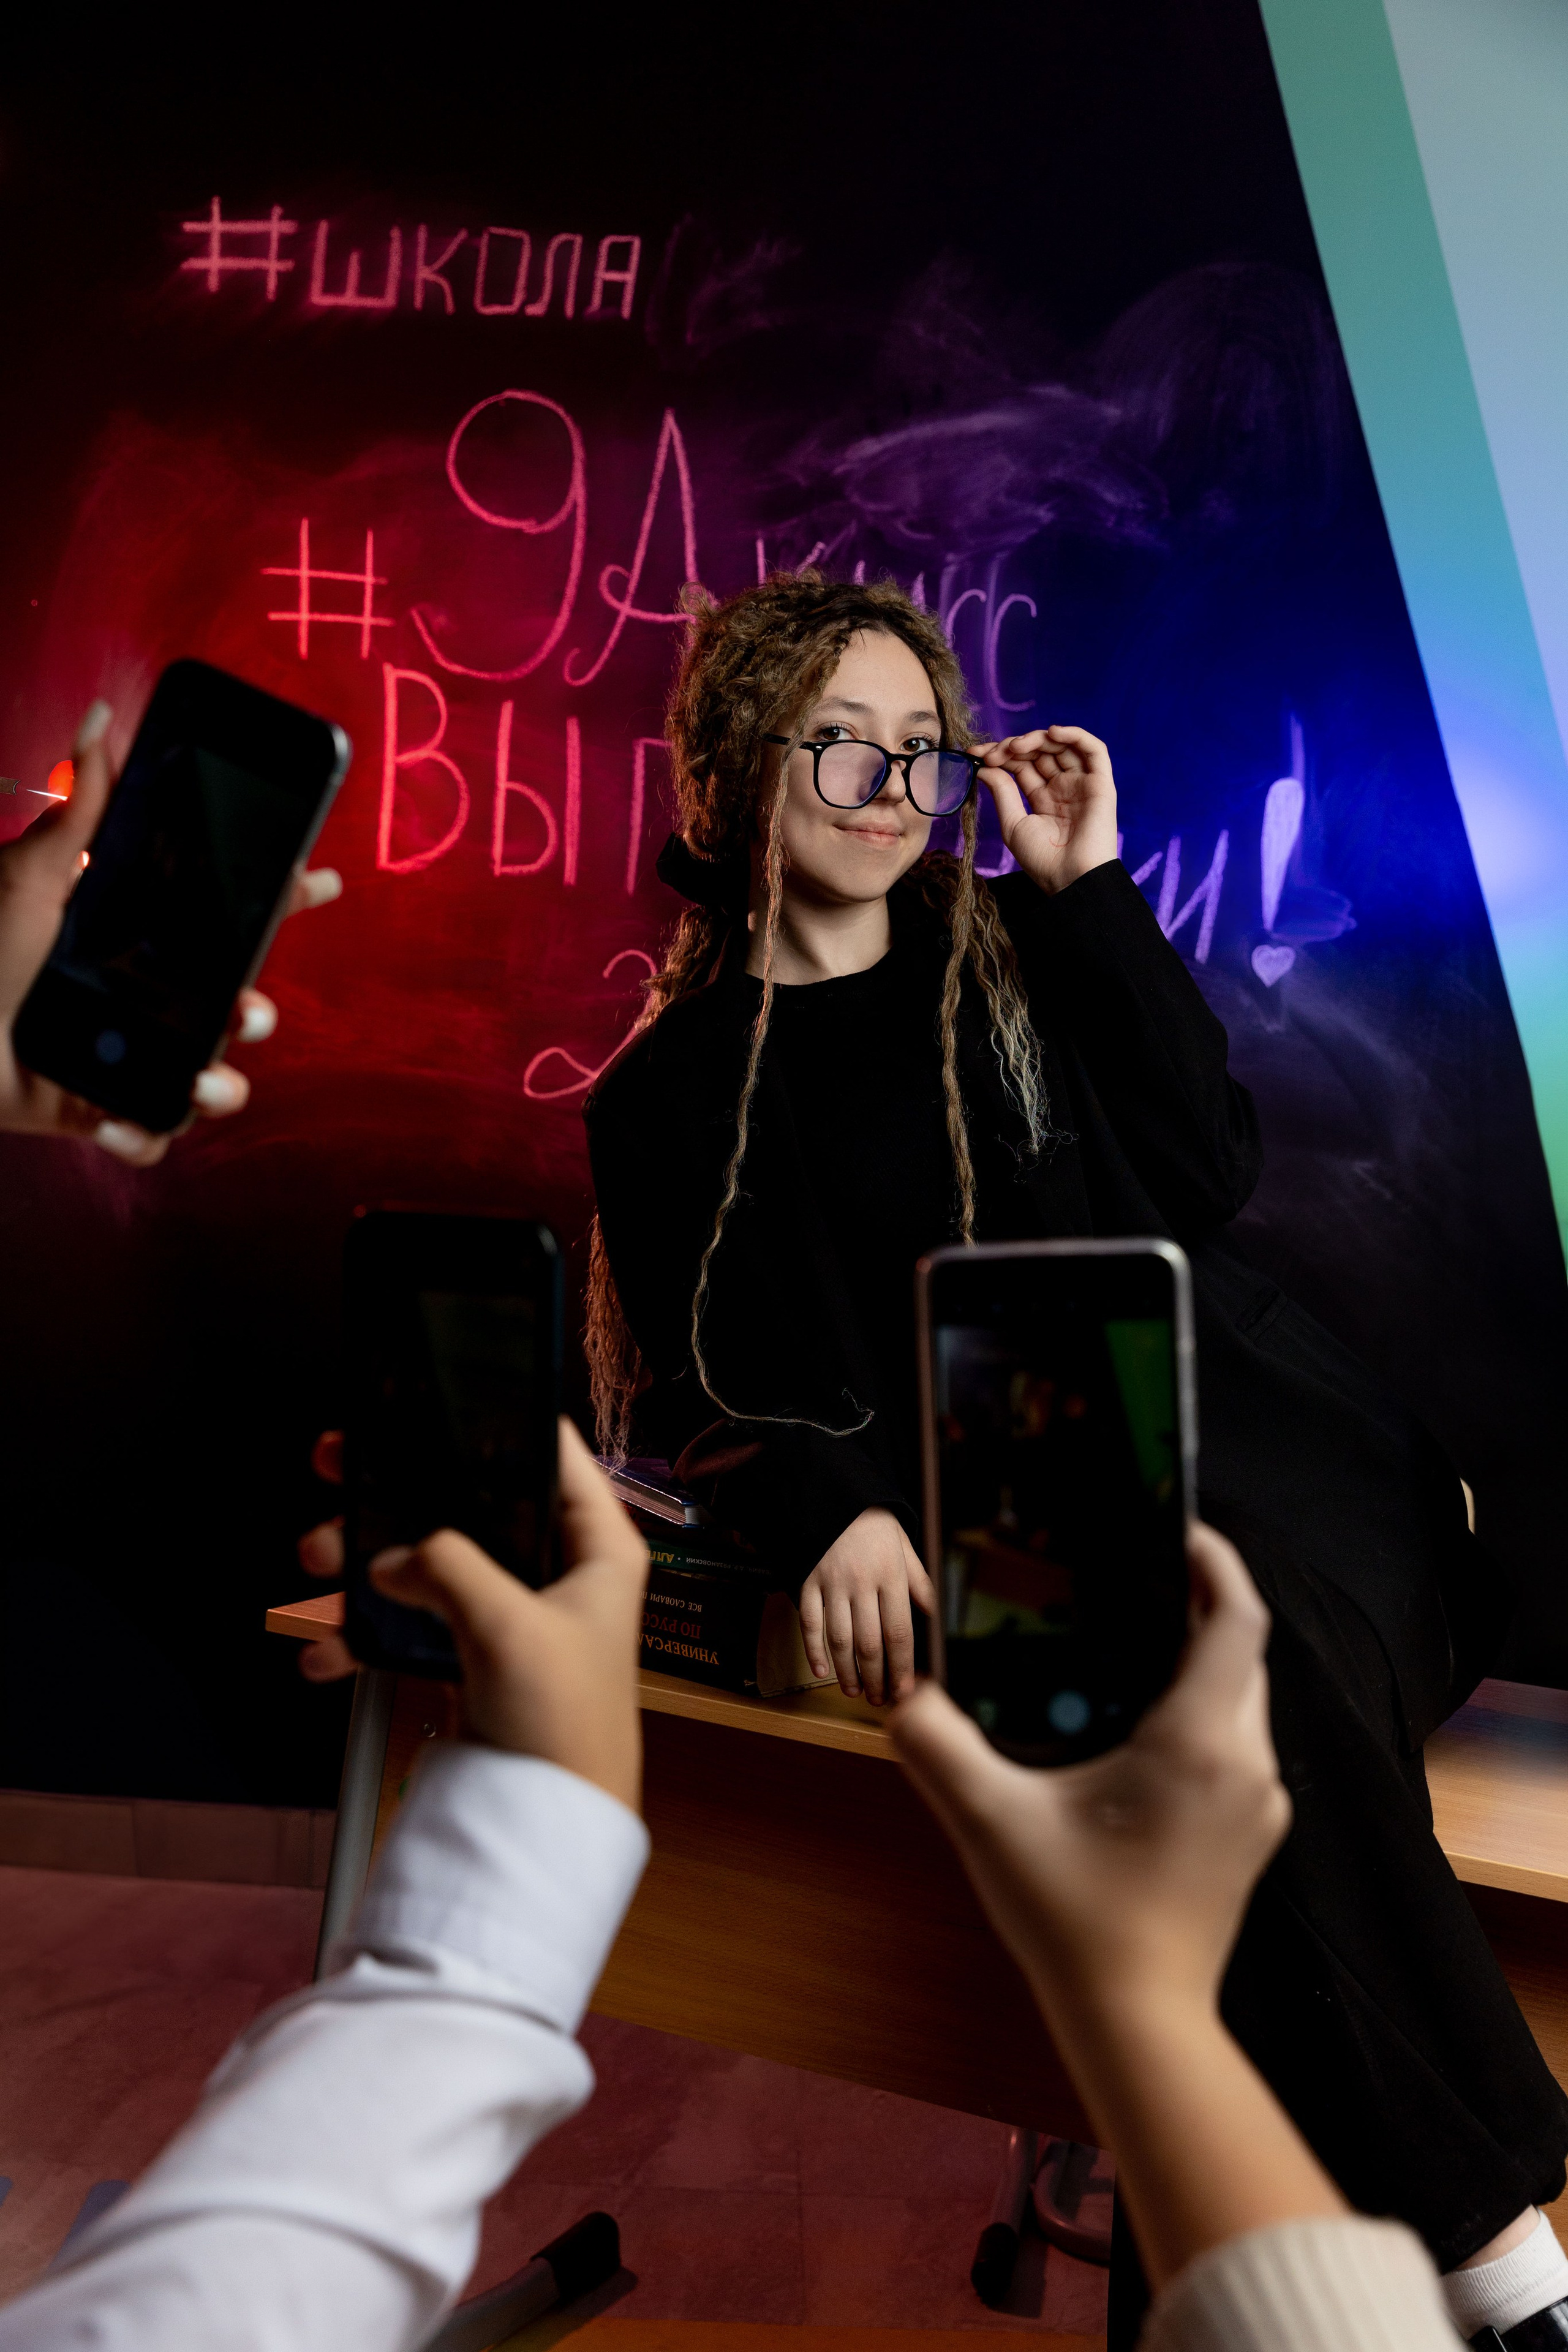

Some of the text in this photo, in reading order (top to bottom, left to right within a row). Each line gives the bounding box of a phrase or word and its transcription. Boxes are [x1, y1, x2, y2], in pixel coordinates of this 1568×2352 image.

[685, 1557, 731, 1569] РЯЗАНОВСКИЙ
[650, 1593, 685, 1608] СЛОВАРИ
[687, 1602, 703, 1613] ВСЕ
[680, 1621, 701, 1640] ПО
